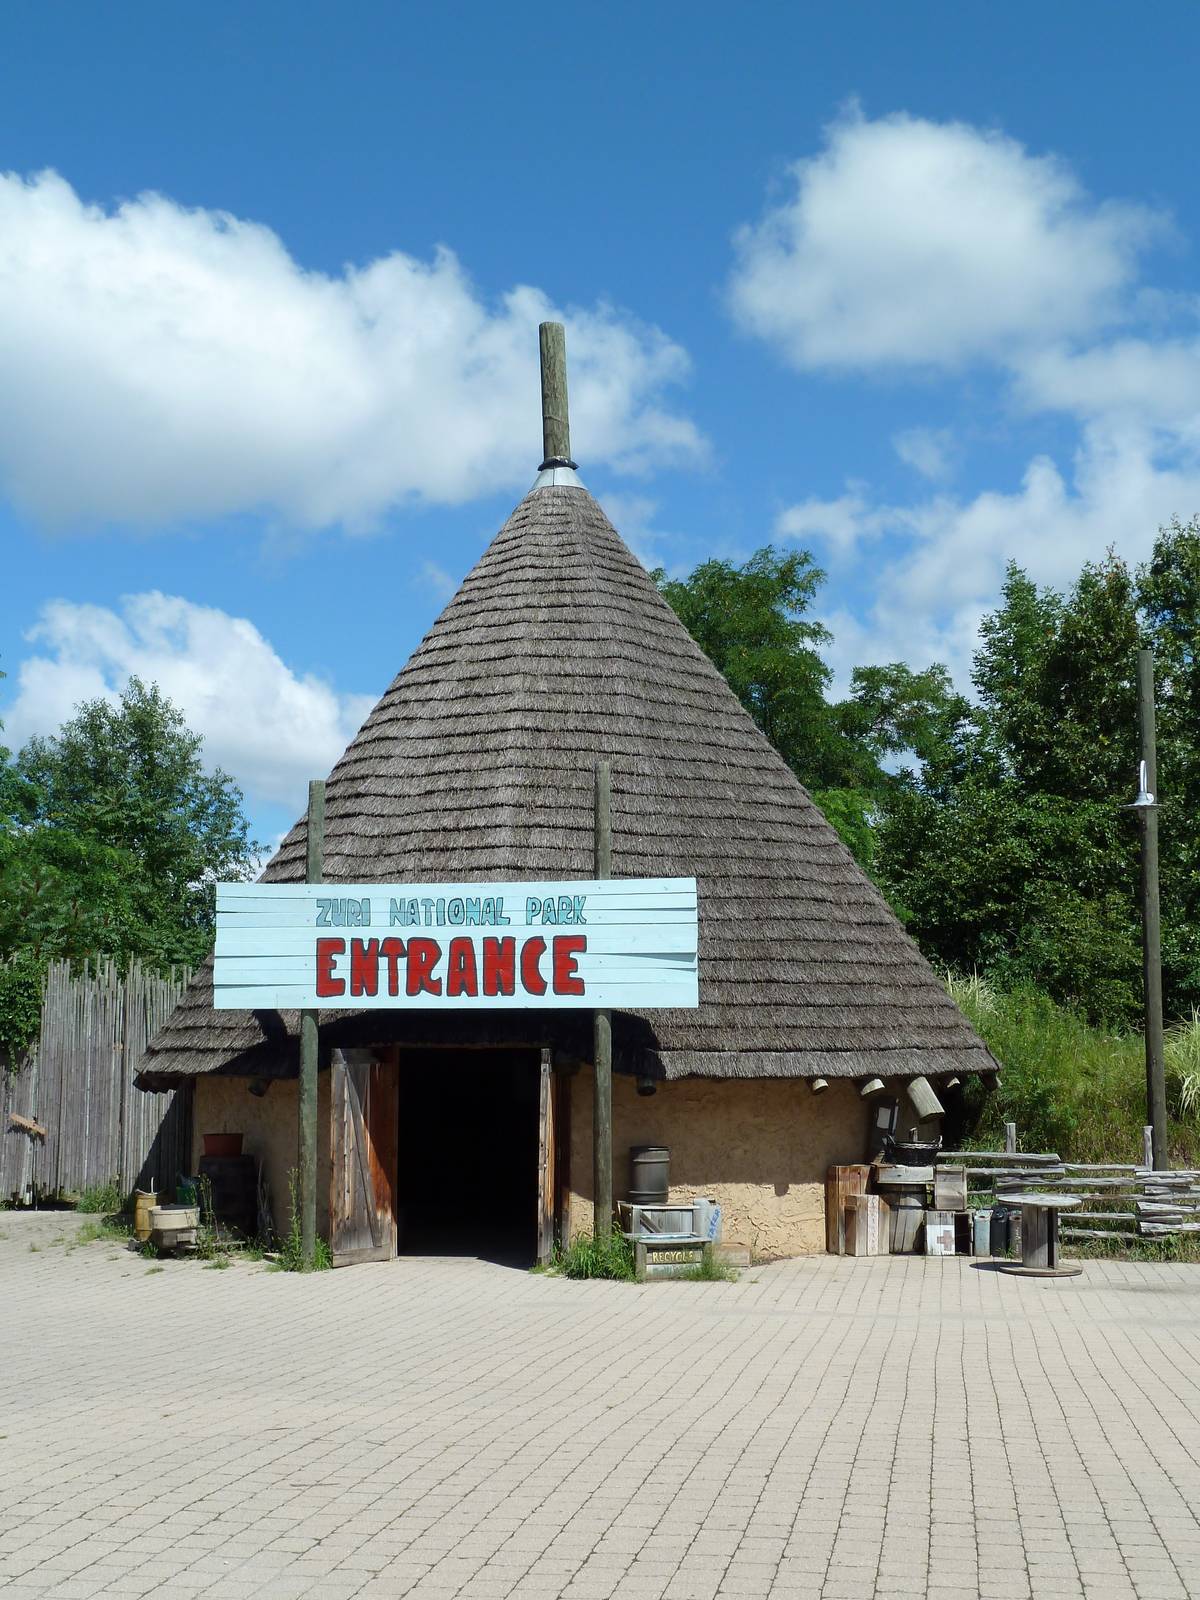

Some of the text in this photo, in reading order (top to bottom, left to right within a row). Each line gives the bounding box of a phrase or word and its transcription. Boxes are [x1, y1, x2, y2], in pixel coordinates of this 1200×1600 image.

[315, 895, 587, 927] ZURI NATIONAL PARK
[316, 935, 588, 997] ENTRANCE
